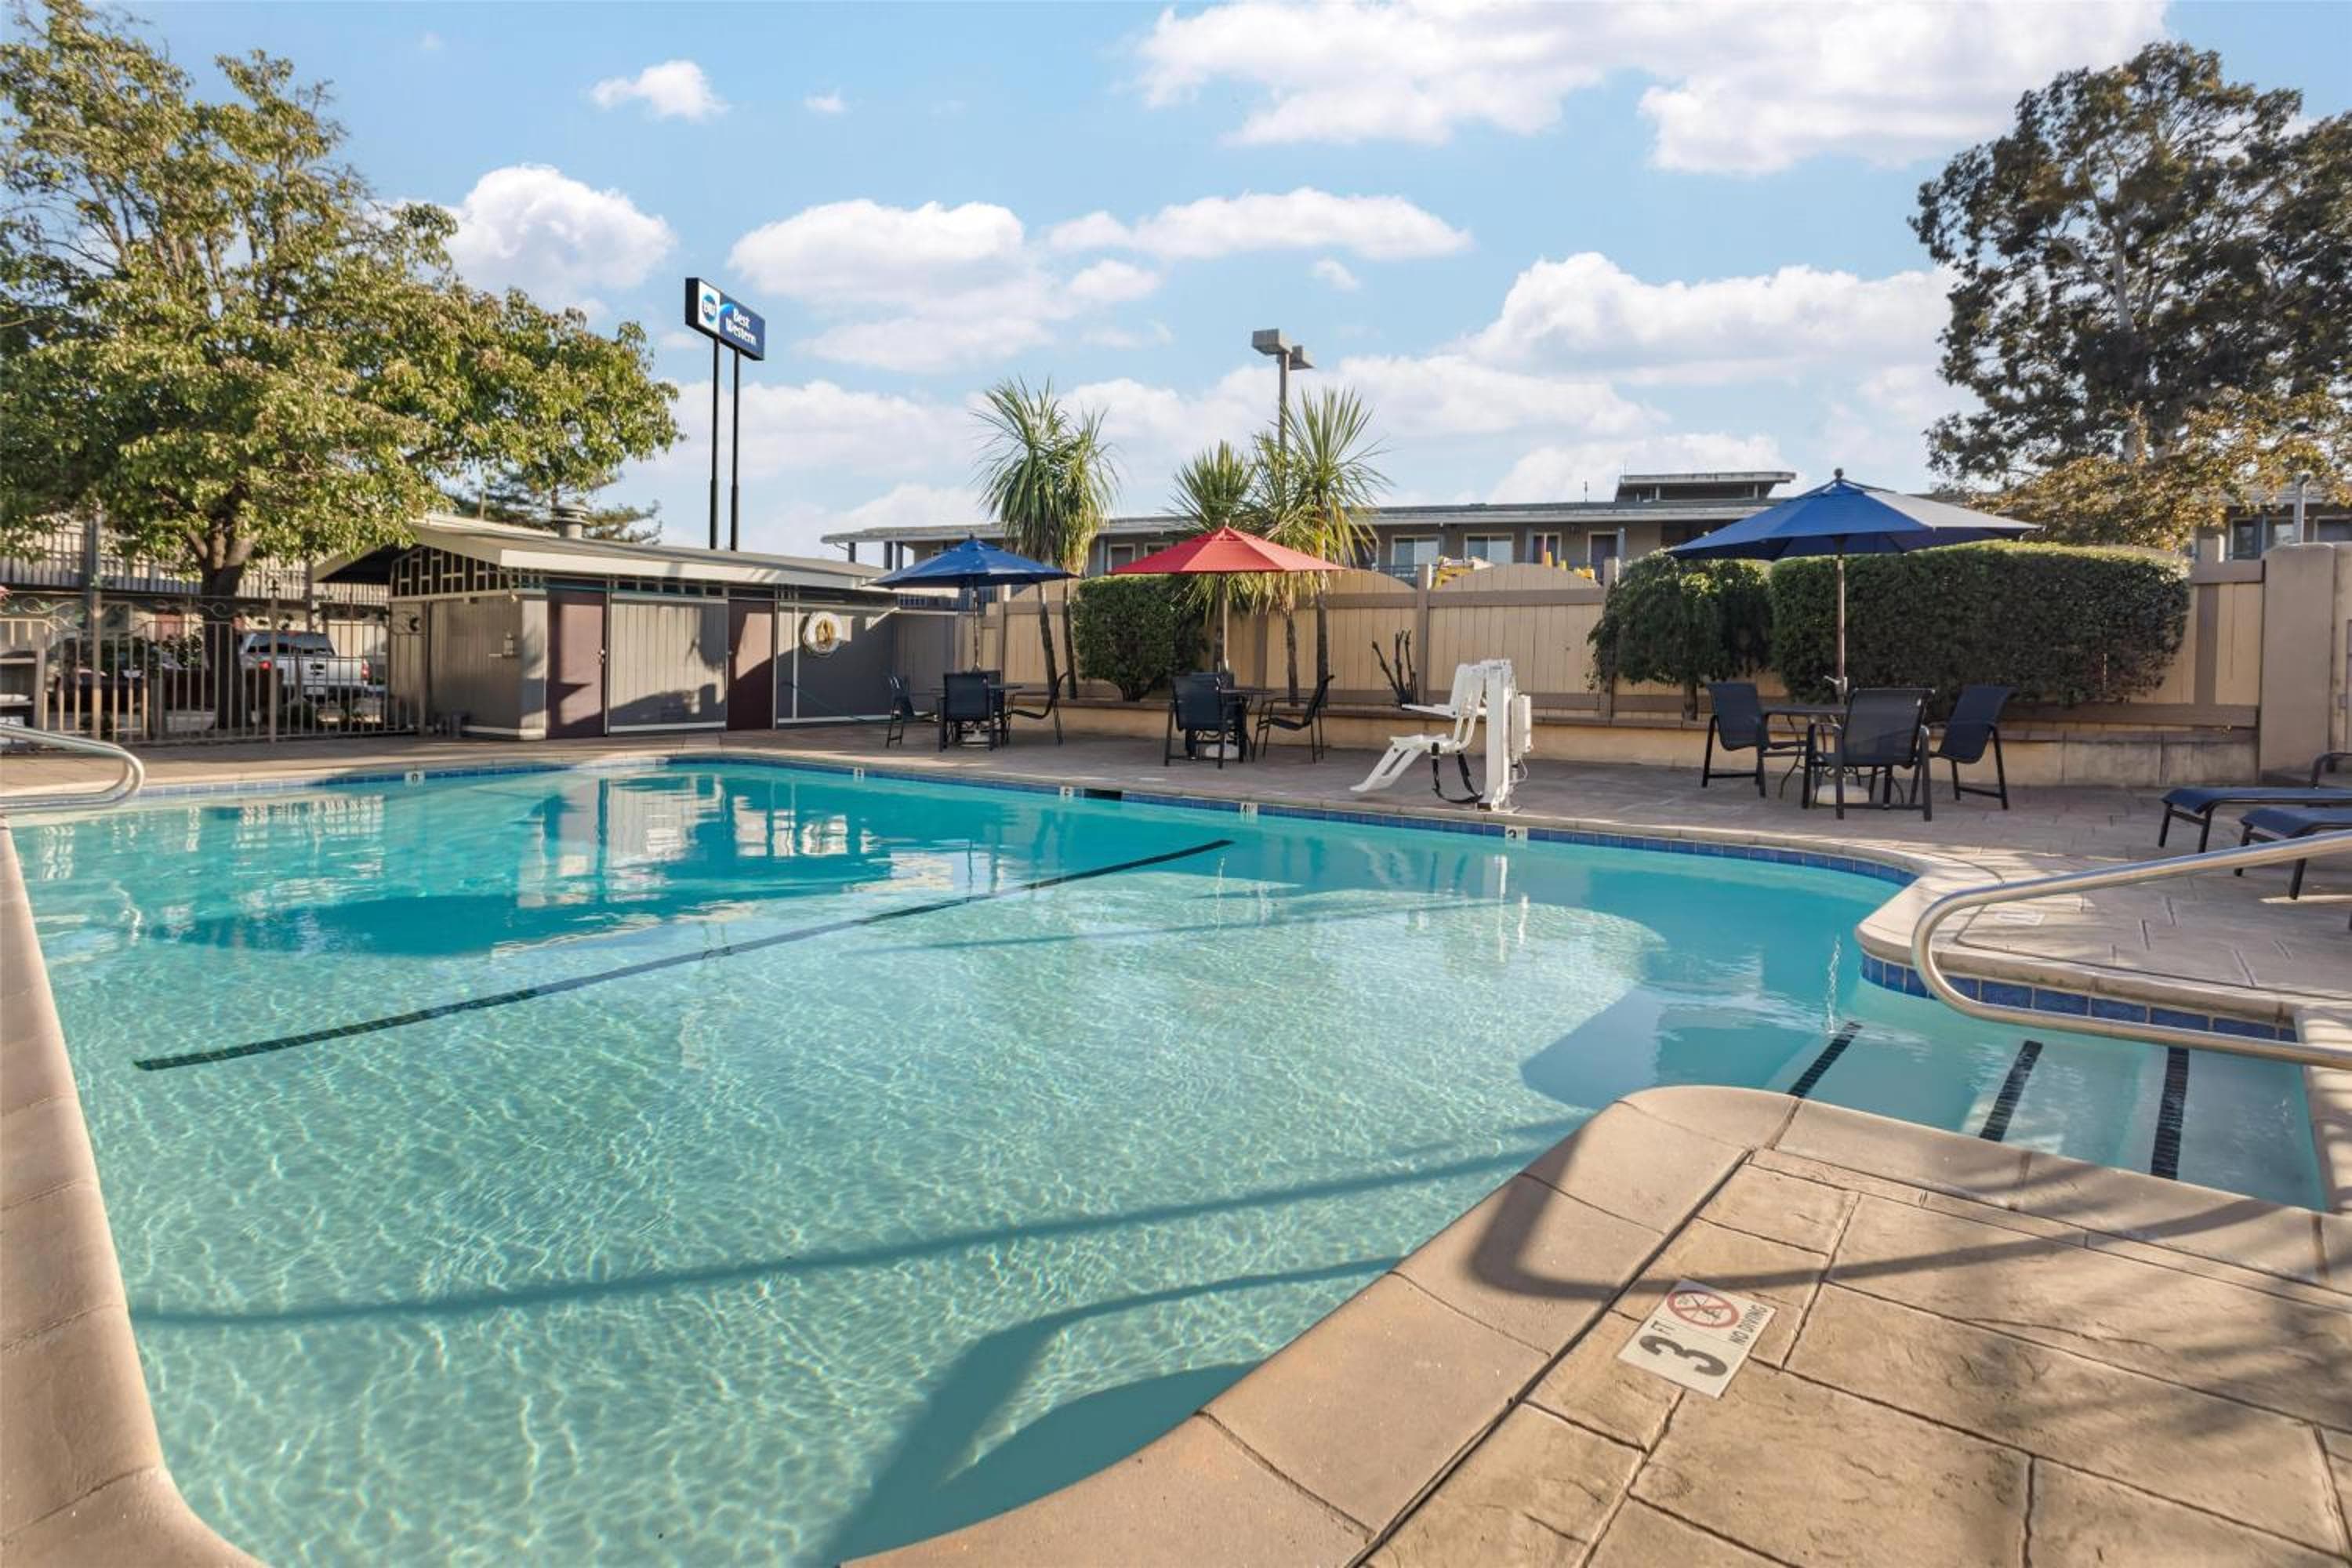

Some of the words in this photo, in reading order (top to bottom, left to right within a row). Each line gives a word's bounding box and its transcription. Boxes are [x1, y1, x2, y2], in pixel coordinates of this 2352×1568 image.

[725, 317, 757, 346] Western
[733, 307, 750, 330] Best
[1650, 1319, 1675, 1336] FT
[1737, 1304, 1769, 1334] DIVING
[1729, 1330, 1750, 1346] NO
[1639, 1335, 1728, 1377] 3
